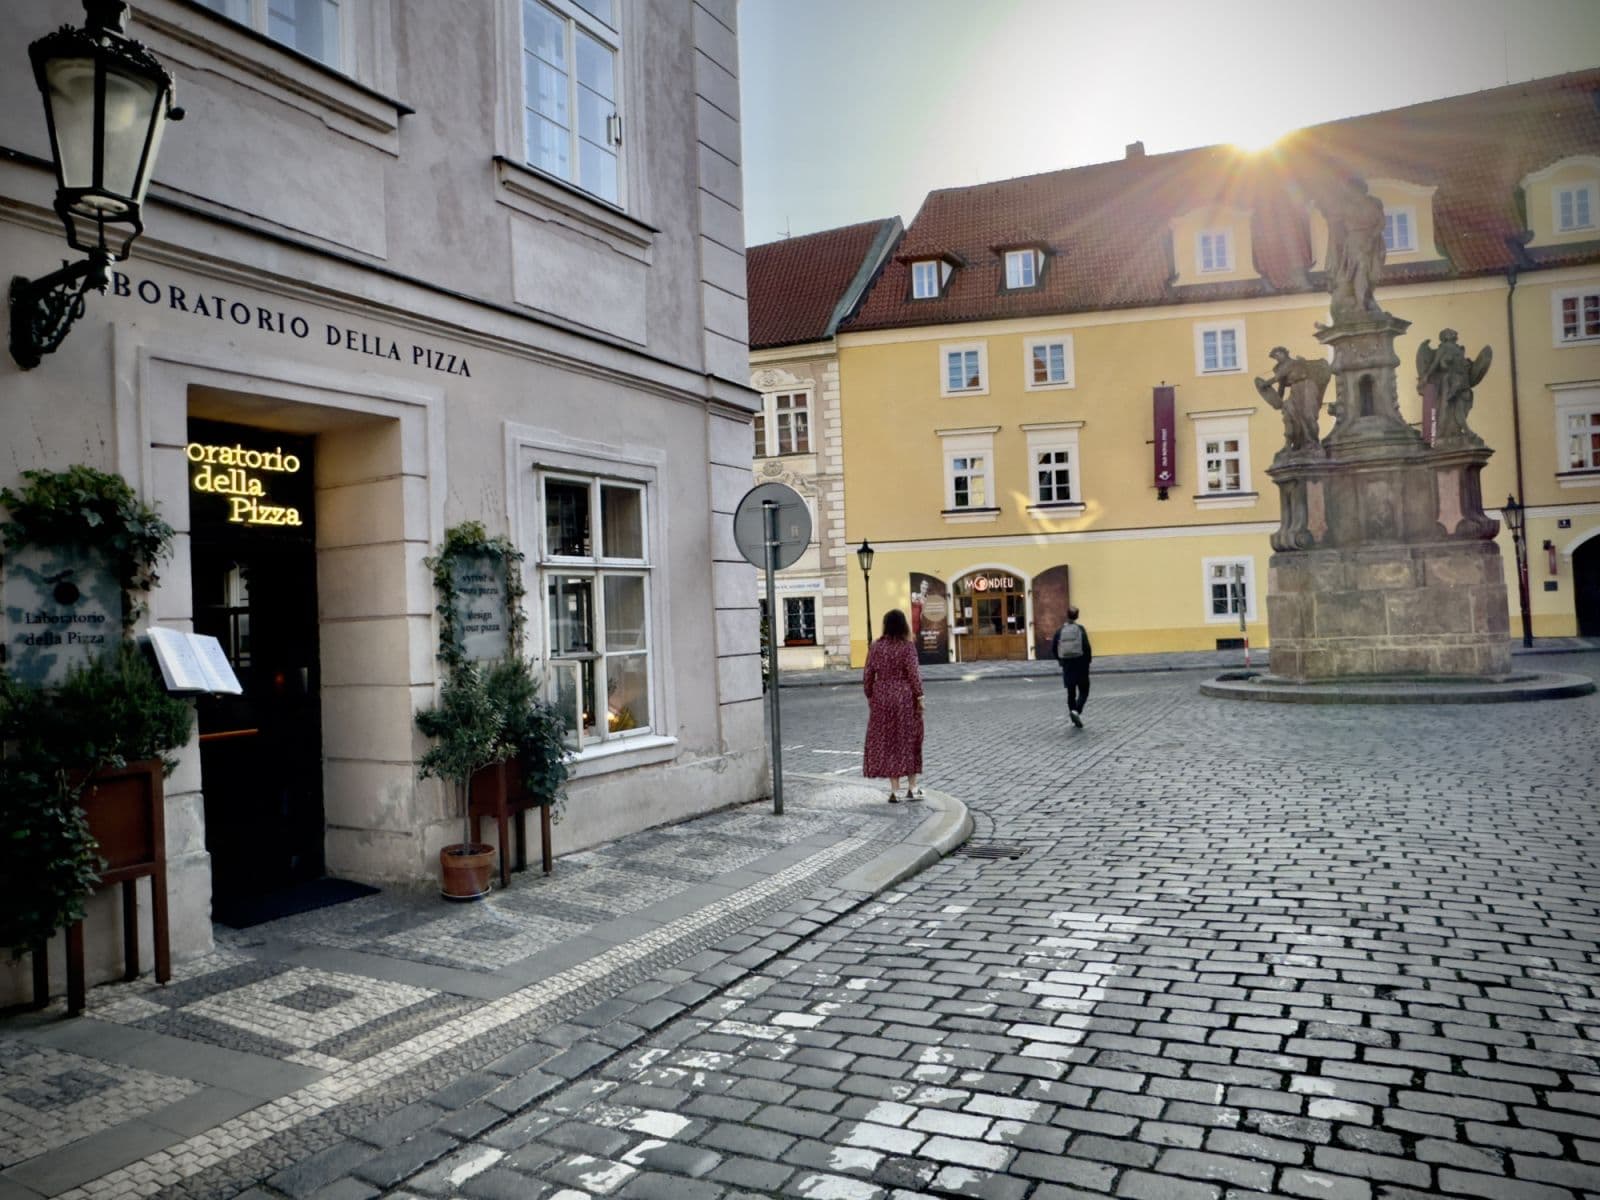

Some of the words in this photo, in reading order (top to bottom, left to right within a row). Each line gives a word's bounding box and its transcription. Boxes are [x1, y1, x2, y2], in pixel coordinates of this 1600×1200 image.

[98, 271, 309, 338] BORATORIO
[326, 324, 401, 361] DELLA
[412, 345, 471, 377] PIZZA
[183, 442, 300, 473] oratorio
[194, 465, 266, 496] della
[229, 496, 303, 525] Pizza
[25, 611, 105, 624] Laboratorio
[24, 631, 62, 645] della
[67, 630, 105, 645] Pizza
